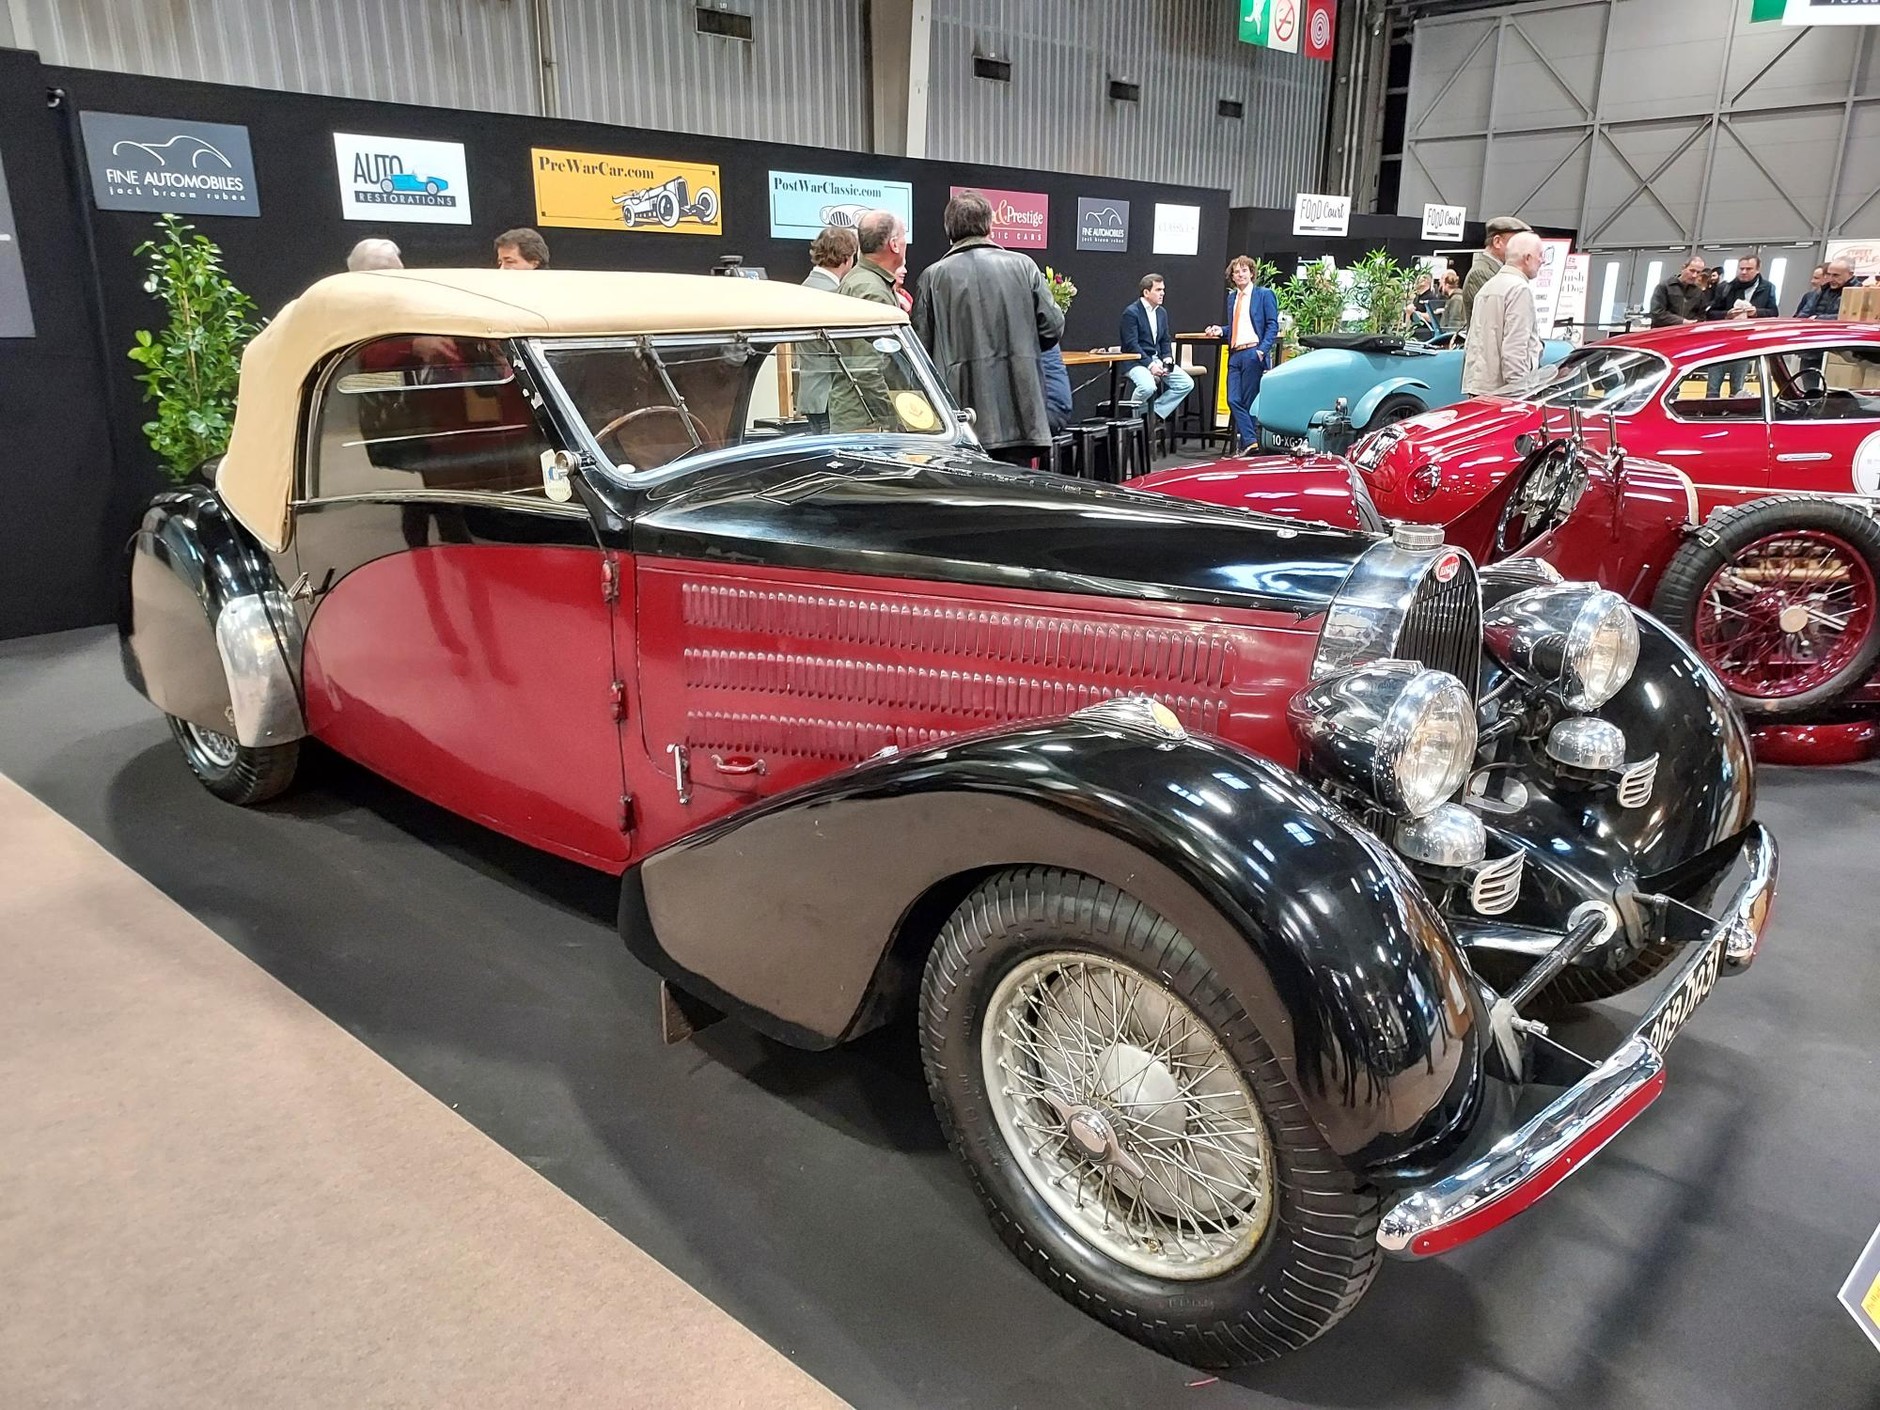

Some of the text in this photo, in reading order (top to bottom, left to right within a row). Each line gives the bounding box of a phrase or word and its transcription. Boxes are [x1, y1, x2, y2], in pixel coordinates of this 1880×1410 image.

[353, 151, 403, 186] AUTO
[538, 155, 655, 180] PreWarCar.com
[106, 169, 244, 191] FINE AUTOMOBILES
[773, 177, 882, 198] PostWarClassic.com
[109, 186, 246, 201] jack braam ruben
[359, 192, 454, 206] RESTORATIONS
[1300, 198, 1345, 223] FOOD Court
[1427, 208, 1462, 229] FOOD Court
